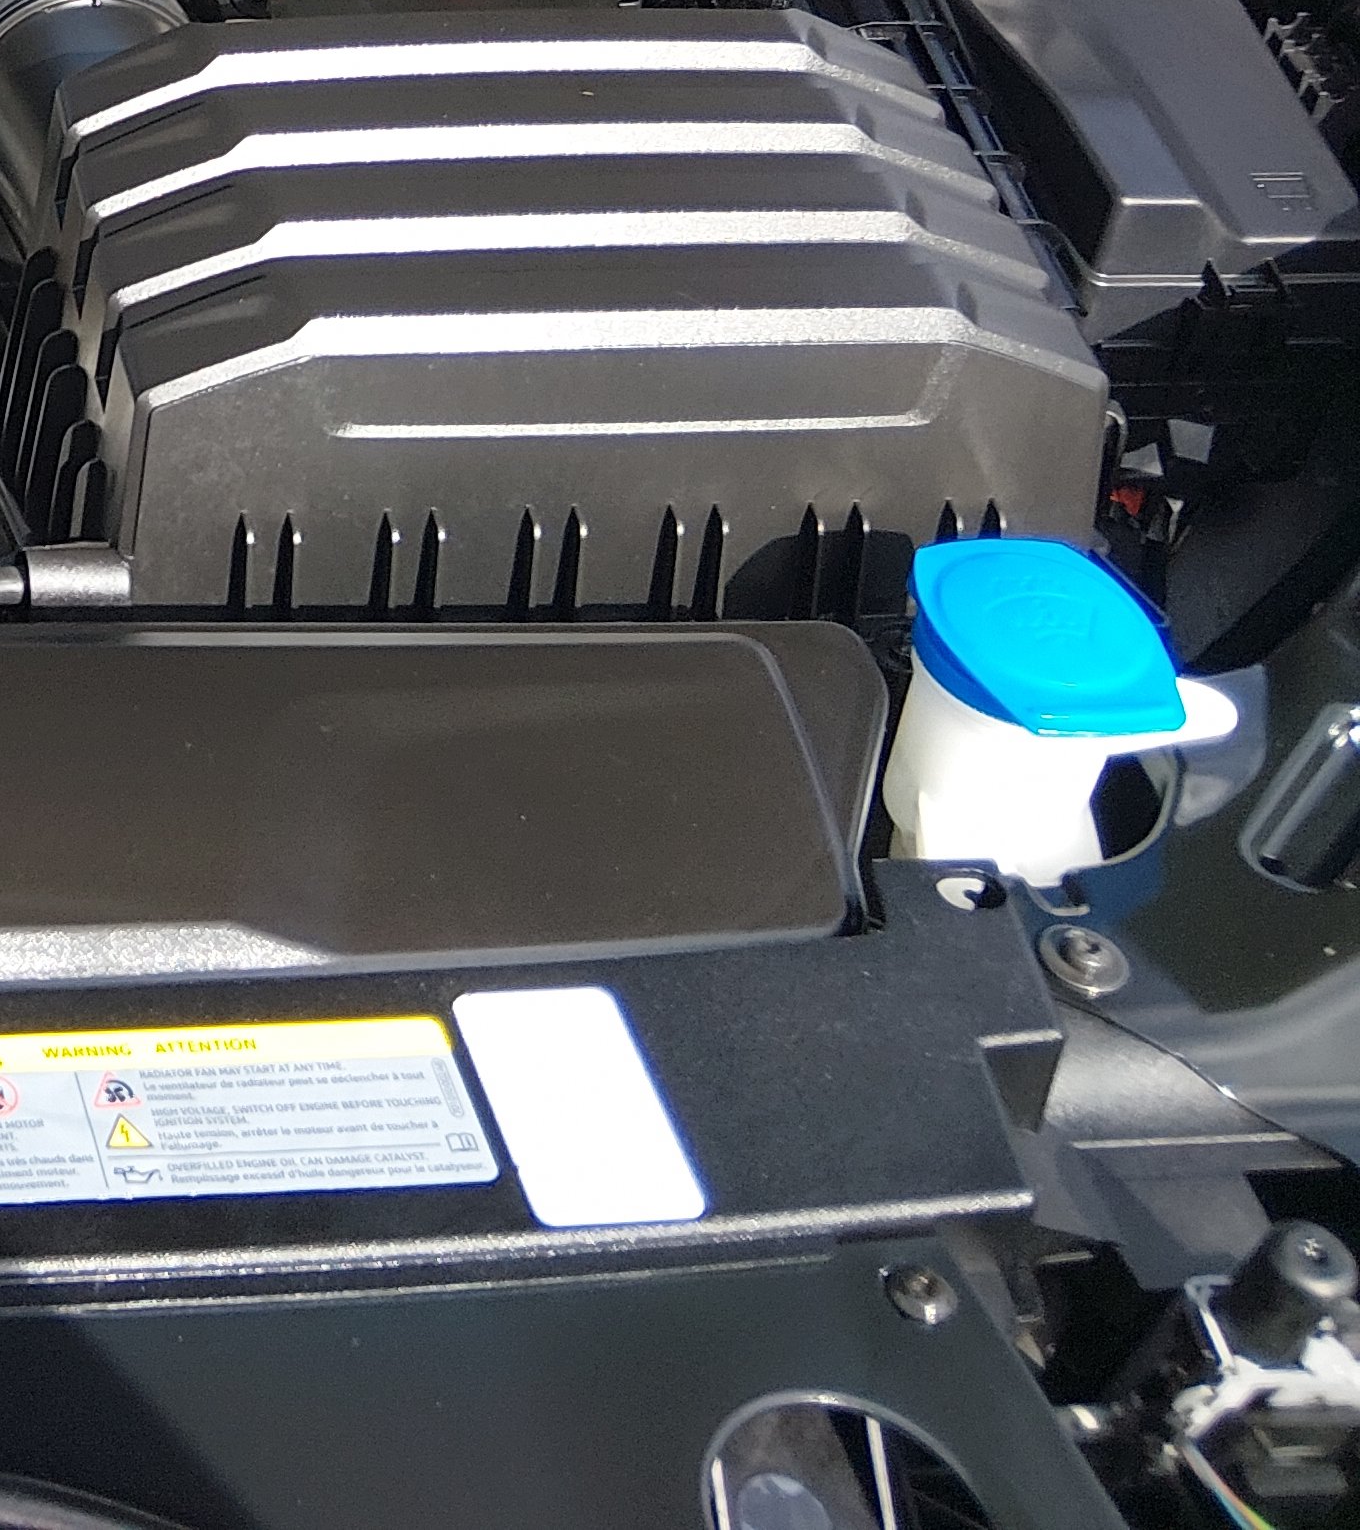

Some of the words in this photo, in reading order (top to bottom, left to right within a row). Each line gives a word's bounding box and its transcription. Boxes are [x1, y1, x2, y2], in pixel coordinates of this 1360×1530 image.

[42, 1044, 132, 1058] WARNING
[155, 1038, 256, 1054] ATTENTION
[139, 1068, 192, 1079] RADIATOR
[195, 1067, 216, 1077] FAN
[219, 1066, 242, 1076] MAY
[244, 1064, 276, 1075] START
[278, 1063, 291, 1073] AT
[293, 1062, 315, 1072] ANY
[158, 1080, 217, 1092] ventilateur
[220, 1079, 233, 1089] de
[236, 1078, 285, 1088] radiateur
[401, 1071, 425, 1081] tout
[151, 1107, 177, 1117] HIGH
[233, 1103, 274, 1114] SWITCH
[275, 1102, 297, 1112] OFF
[299, 1100, 339, 1111] ENGINE
[342, 1098, 383, 1109] BEFORE
[386, 1096, 441, 1109] TOUCHING
[4, 1118, 45, 1129] MOTOR
[154, 1115, 203, 1126] IGNITION
[158, 1129, 191, 1141] Haute
[281, 1126, 291, 1136] le
[294, 1125, 335, 1135] moteur
[337, 1123, 367, 1133] avant
[370, 1122, 384, 1132] de
[386, 1120, 428, 1131] toucher
[29, 1155, 66, 1165] chauds
[68, 1154, 95, 1163] dans
[167, 1159, 233, 1171] OVERFILLED
[236, 1157, 277, 1168] ENGINE
[279, 1156, 297, 1167] OIL
[300, 1155, 323, 1166] CAN
[325, 1154, 371, 1165] DAMAGE
[170, 1172, 240, 1184] Remplissage
[242, 1169, 285, 1180] excessif
[287, 1168, 326, 1179] d'huile
[327, 1166, 385, 1179] dangereux
[387, 1165, 411, 1177] pour
[414, 1163, 425, 1173] le
